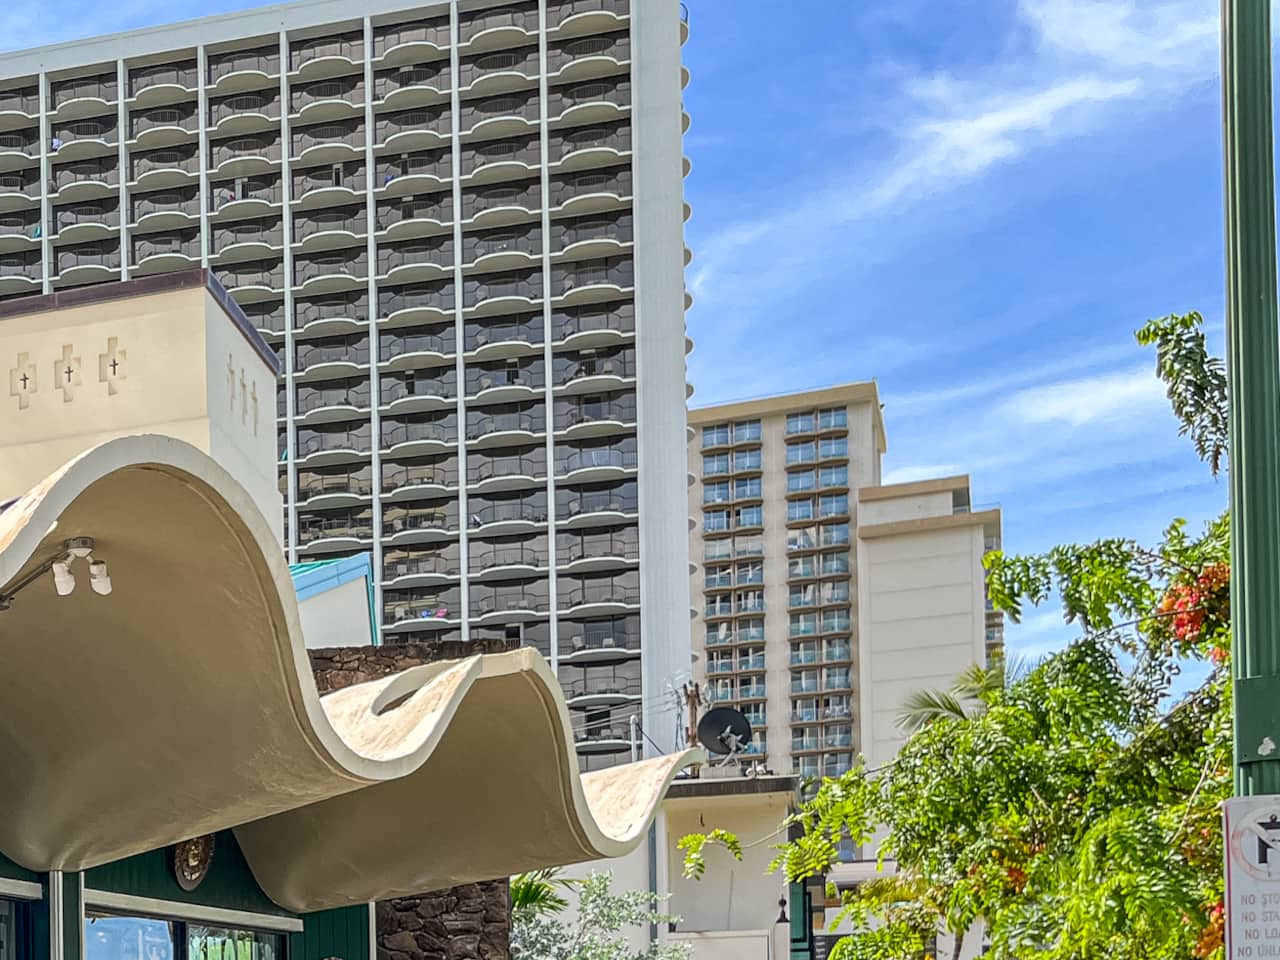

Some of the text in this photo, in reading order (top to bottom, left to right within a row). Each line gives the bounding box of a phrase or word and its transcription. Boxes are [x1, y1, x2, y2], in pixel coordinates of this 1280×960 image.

[1240, 894, 1255, 905] NO
[1241, 911, 1256, 922] NO
[1244, 928, 1260, 940] NO
[1237, 946, 1252, 957] NO
